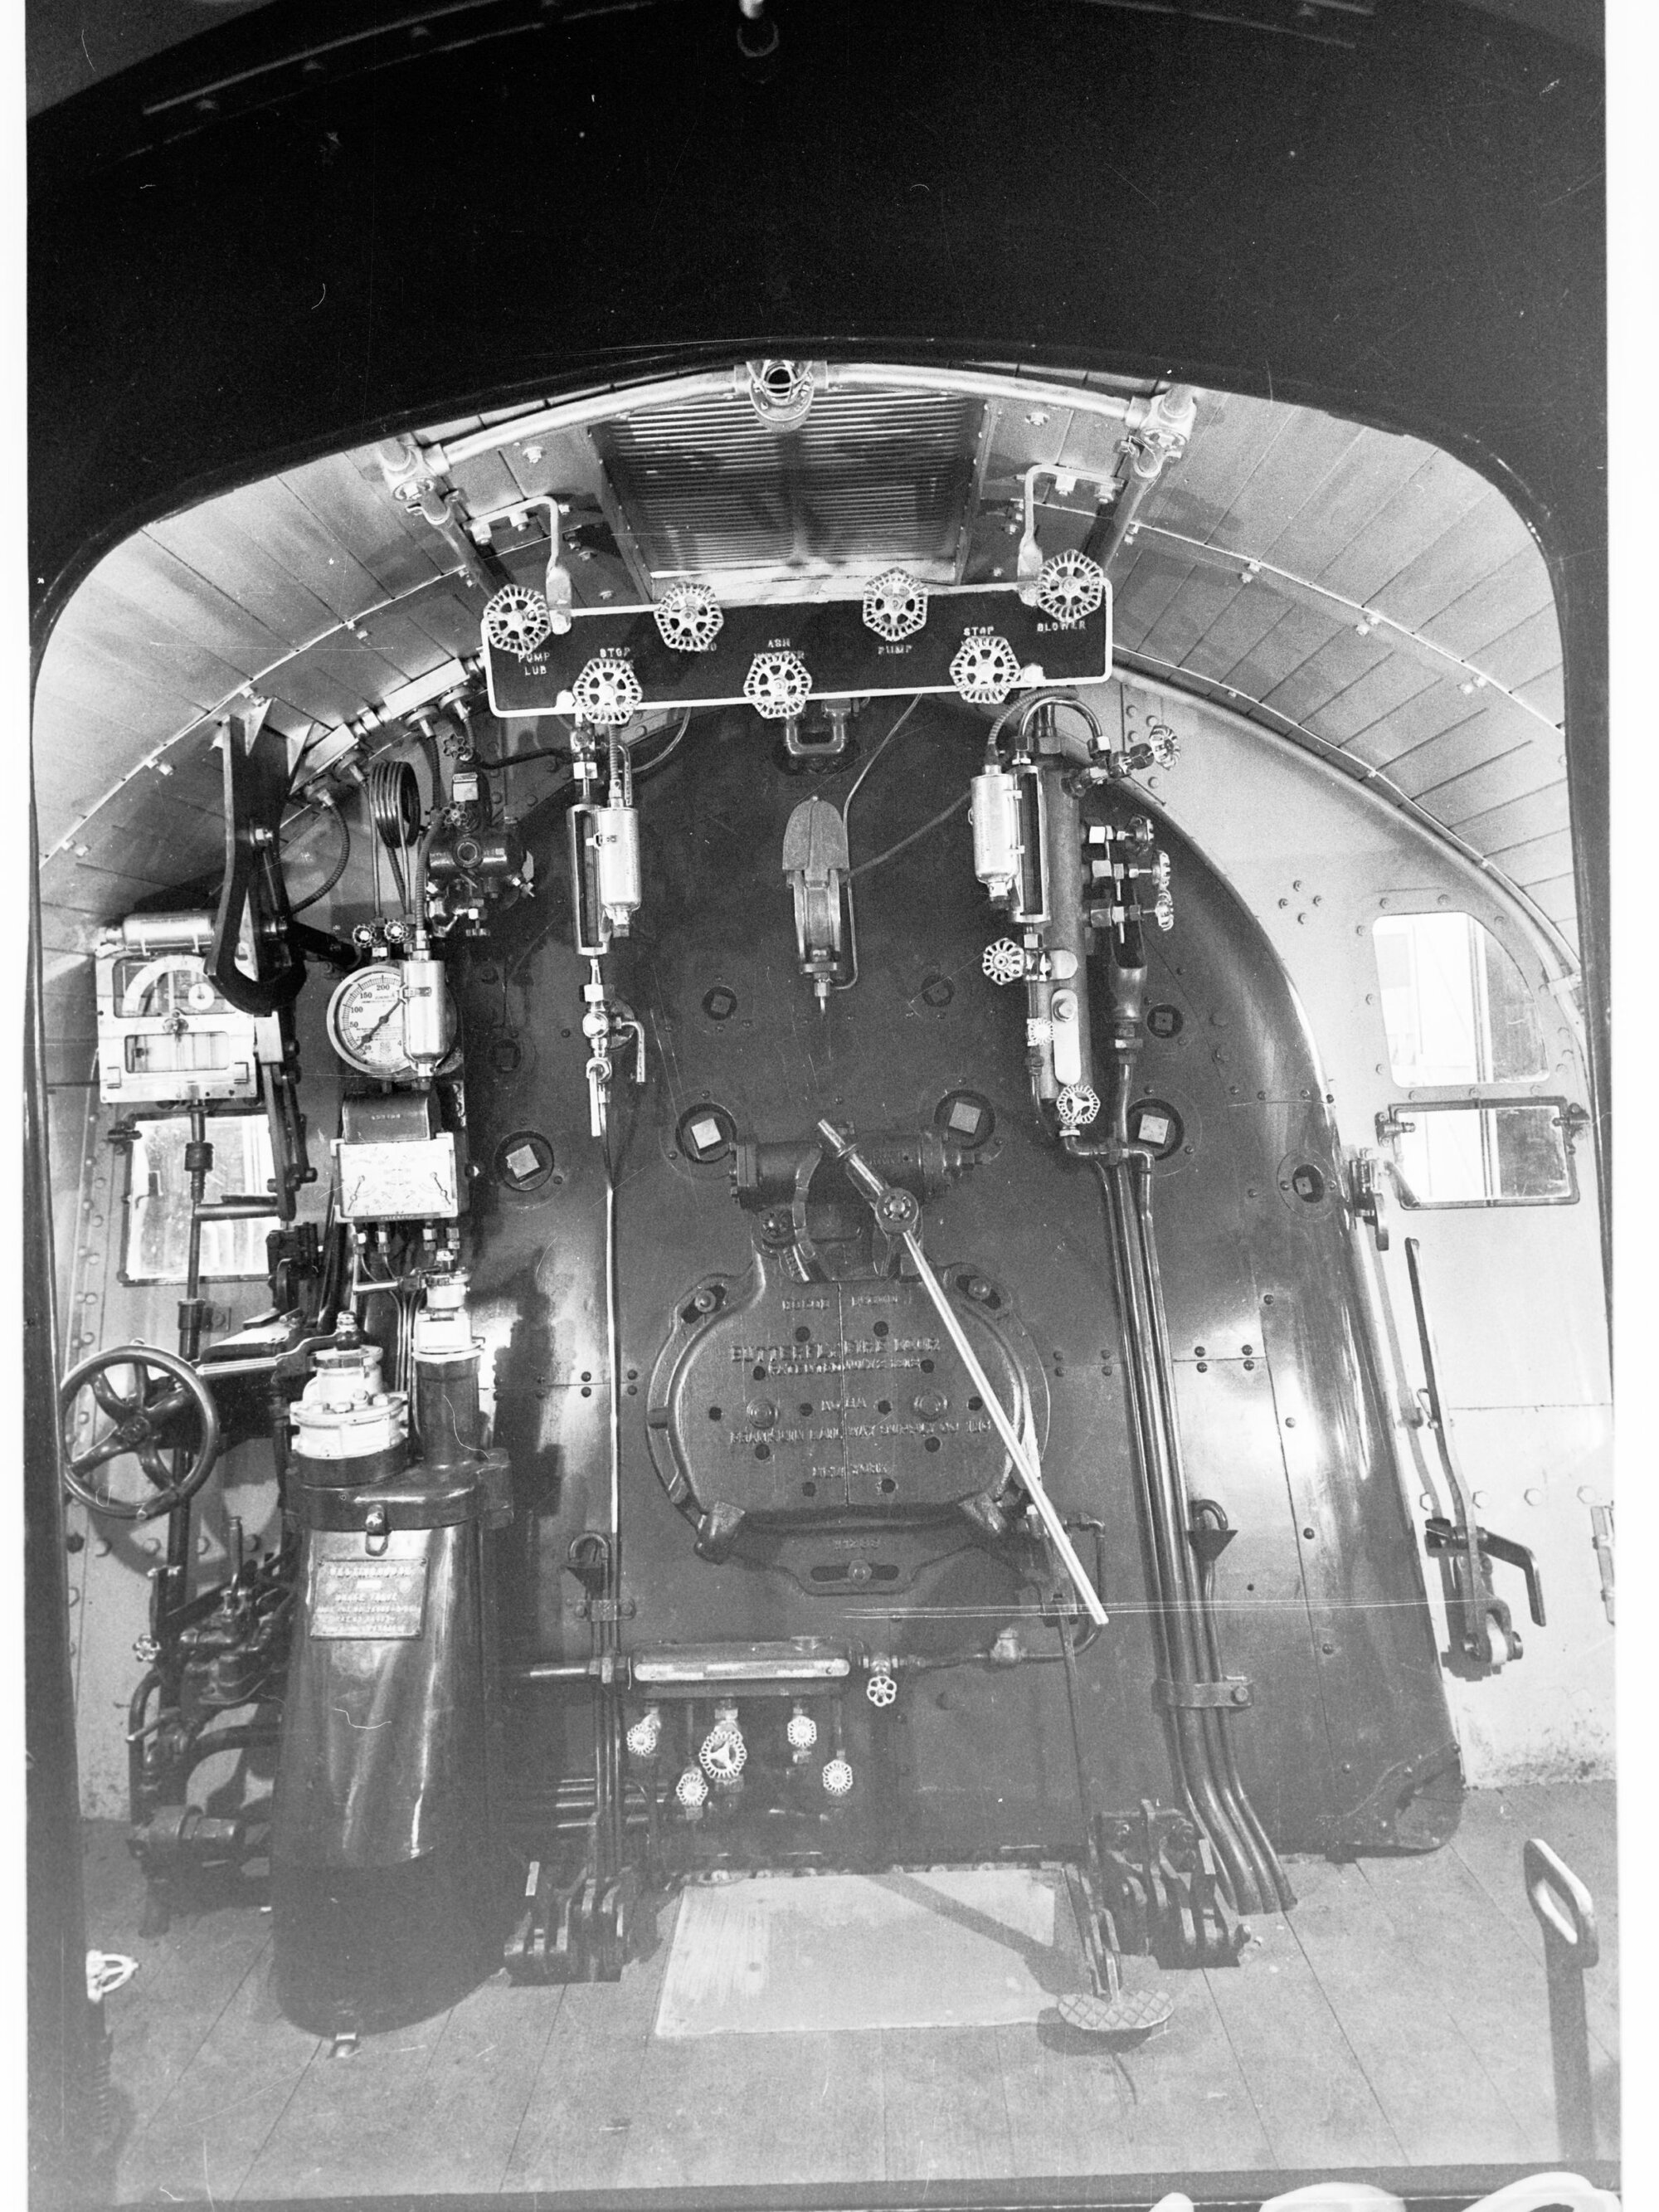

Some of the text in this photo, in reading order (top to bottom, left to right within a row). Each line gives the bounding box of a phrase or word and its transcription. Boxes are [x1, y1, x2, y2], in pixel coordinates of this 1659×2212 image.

[1037, 621, 1087, 632] BLOWER
[878, 645, 912, 655] PUMP
[518, 652, 550, 663] PUMP
[524, 665, 547, 676] LUB
